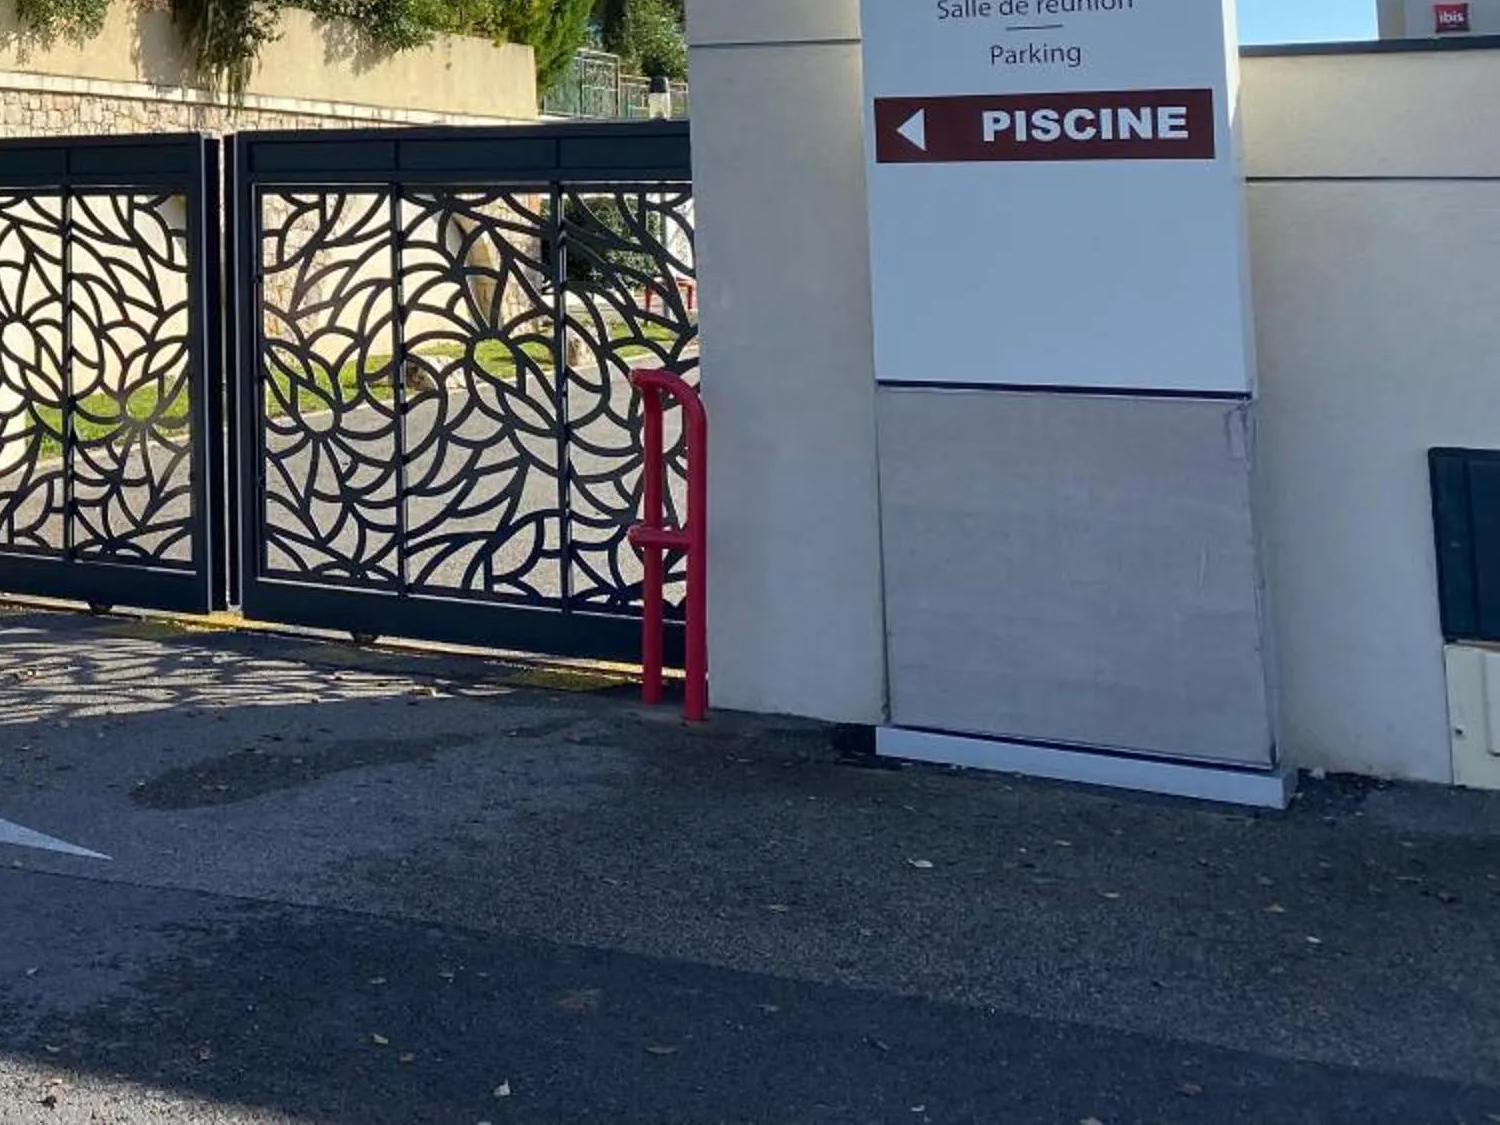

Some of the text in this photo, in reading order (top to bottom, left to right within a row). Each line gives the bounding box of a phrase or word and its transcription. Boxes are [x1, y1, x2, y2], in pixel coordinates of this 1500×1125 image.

[1438, 10, 1465, 24] ibis
[989, 42, 1083, 68] Parking
[981, 105, 1190, 143] PISCINE
